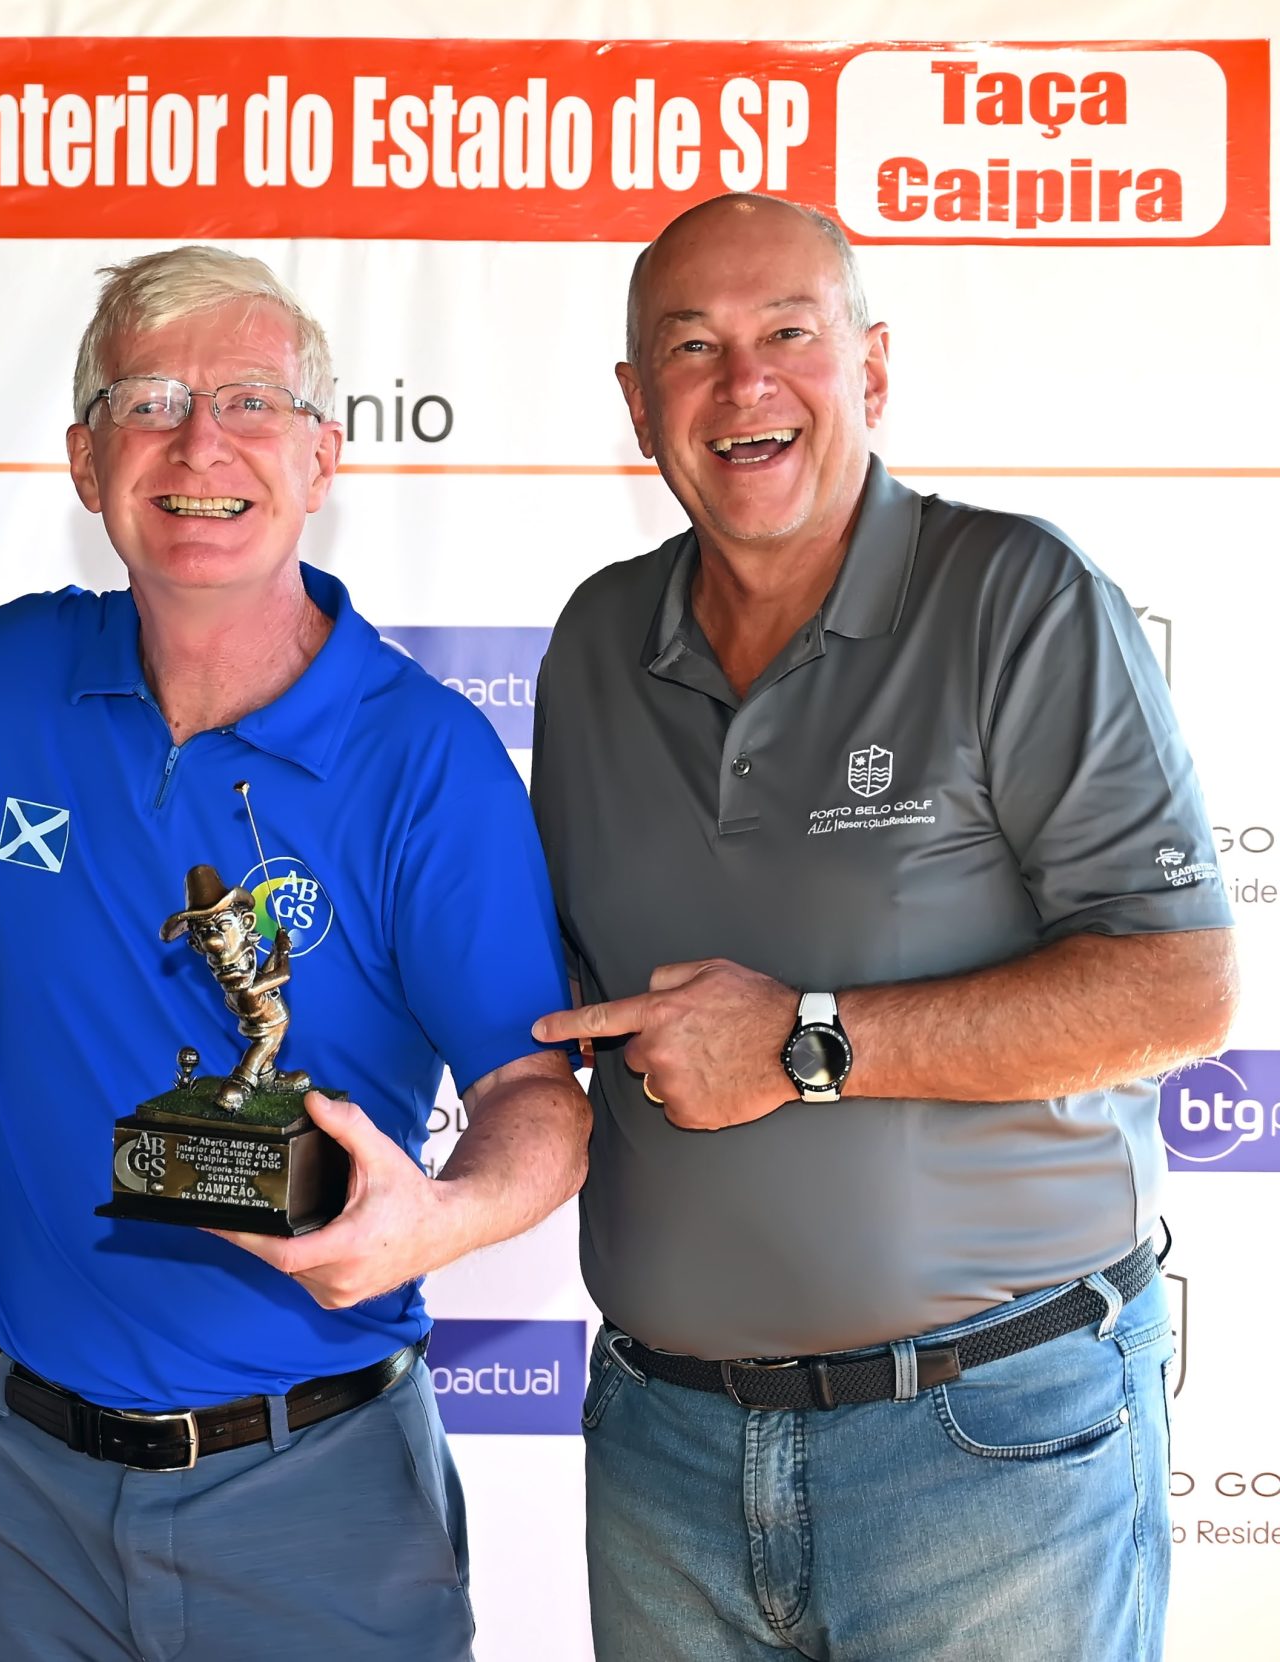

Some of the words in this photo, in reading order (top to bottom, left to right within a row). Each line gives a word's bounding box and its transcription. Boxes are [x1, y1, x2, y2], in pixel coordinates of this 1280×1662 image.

[930, 60, 1128, 139] Taça
[243, 74, 334, 190] do
[351, 75, 594, 191] Estado
[610, 78, 702, 192] de
[719, 77, 810, 193] SP
[876, 156, 1184, 230] Caipira
[334, 377, 454, 443] nio
[809, 806, 852, 820] PORTO
[854, 804, 892, 816] BELO
[893, 799, 933, 811] GOLF
[807, 820, 834, 835] ALL
[1172, 874, 1194, 887] GOLF
[1230, 878, 1278, 903] ide
[1180, 1088, 1264, 1142] btg
[176, 1143, 208, 1154] Interior
[210, 1147, 221, 1155] do
[223, 1148, 253, 1158] Estado
[255, 1152, 266, 1160] de
[268, 1152, 281, 1161] SP
[199, 1137, 228, 1148] Aberto
[230, 1140, 255, 1151] ABGS
[257, 1143, 269, 1153] do
[175, 1151, 195, 1162] Taça
[235, 1158, 251, 1166] IGC
[261, 1160, 281, 1169] DGC
[195, 1162, 232, 1174] Categoria
[234, 1166, 260, 1176] Sênior
[207, 1173, 246, 1184] SCRATCH
[181, 1191, 191, 1199] 02
[208, 1194, 217, 1202] de
[219, 1196, 239, 1204] Julho
[196, 1181, 256, 1198] CAMPEÃO
